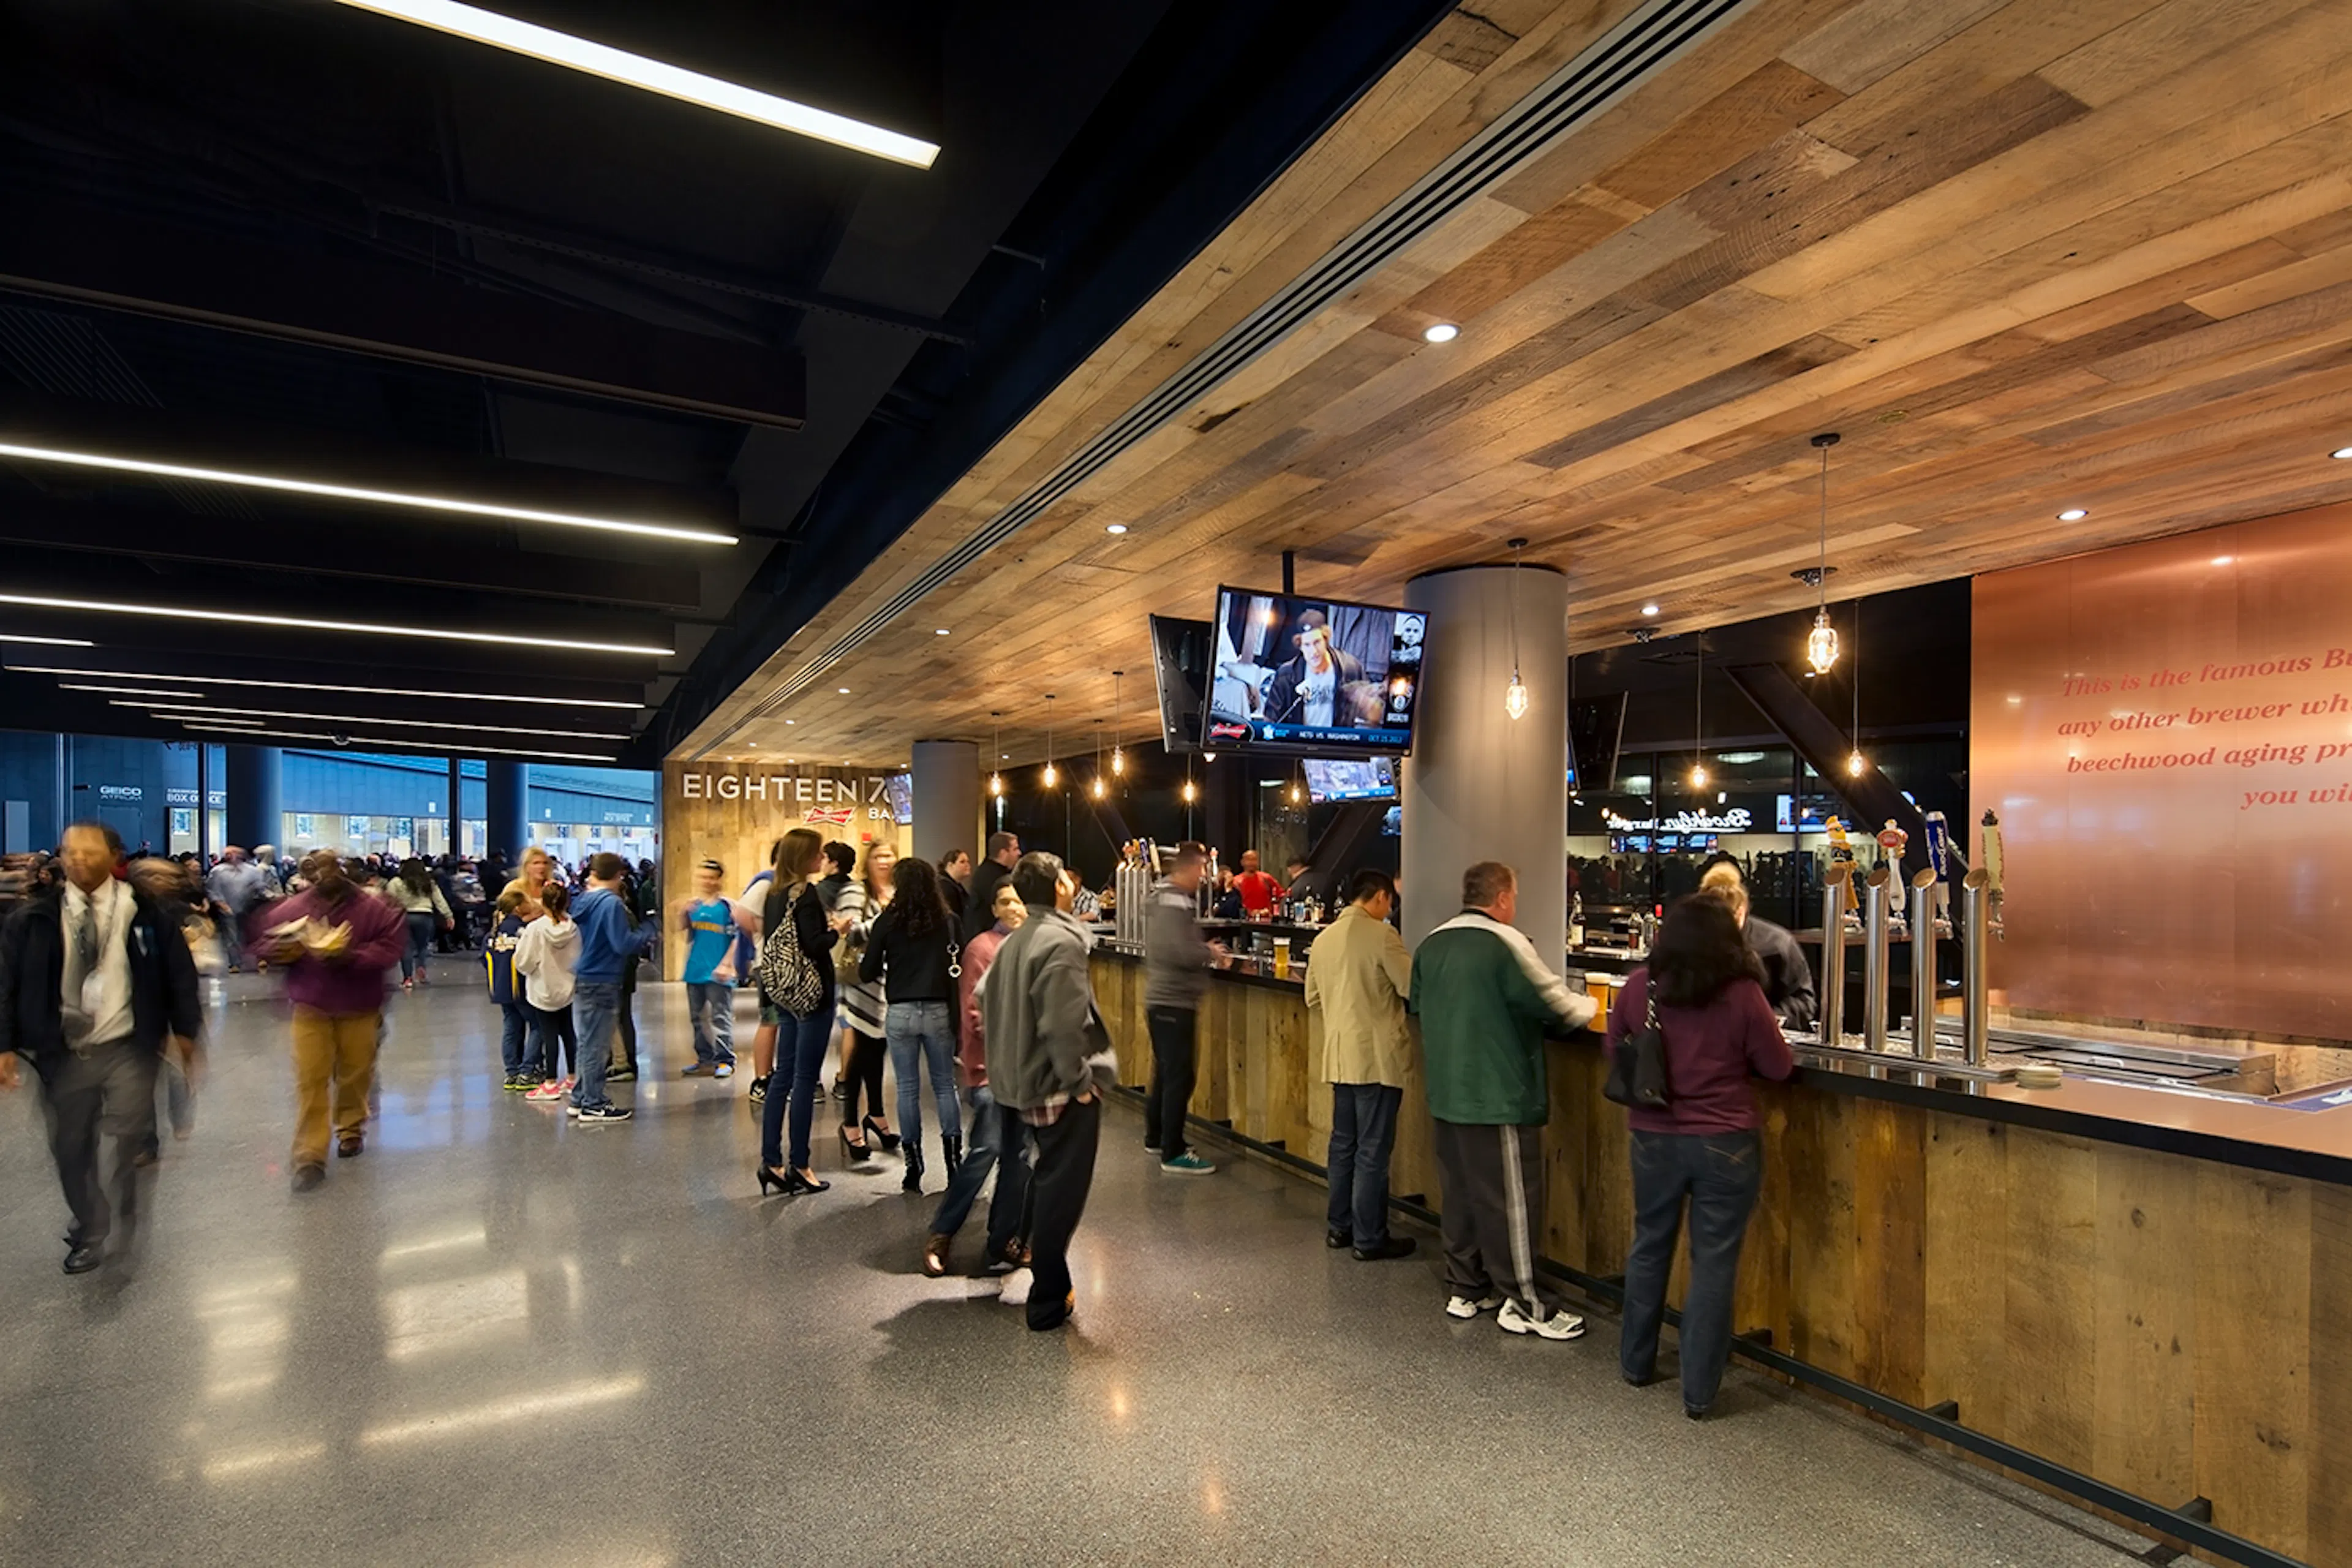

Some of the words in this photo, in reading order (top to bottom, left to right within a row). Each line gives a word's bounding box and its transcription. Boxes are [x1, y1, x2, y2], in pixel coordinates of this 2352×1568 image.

[2063, 676, 2113, 696] This
[2120, 673, 2142, 691] is
[2149, 668, 2192, 687] the
[2199, 656, 2313, 682] famous
[2057, 720, 2102, 737] any
[2109, 711, 2180, 731] other
[2187, 703, 2293, 725] brewer
[2301, 693, 2352, 715] wh
[2067, 747, 2217, 773] beechwood
[2223, 742, 2309, 768] aging
[100, 785, 142, 796] GEICO
[167, 793, 189, 803] BOX
[683, 773, 858, 803] EIGHTEEN
[2239, 790, 2298, 810] you
[868, 807, 895, 820] BA
